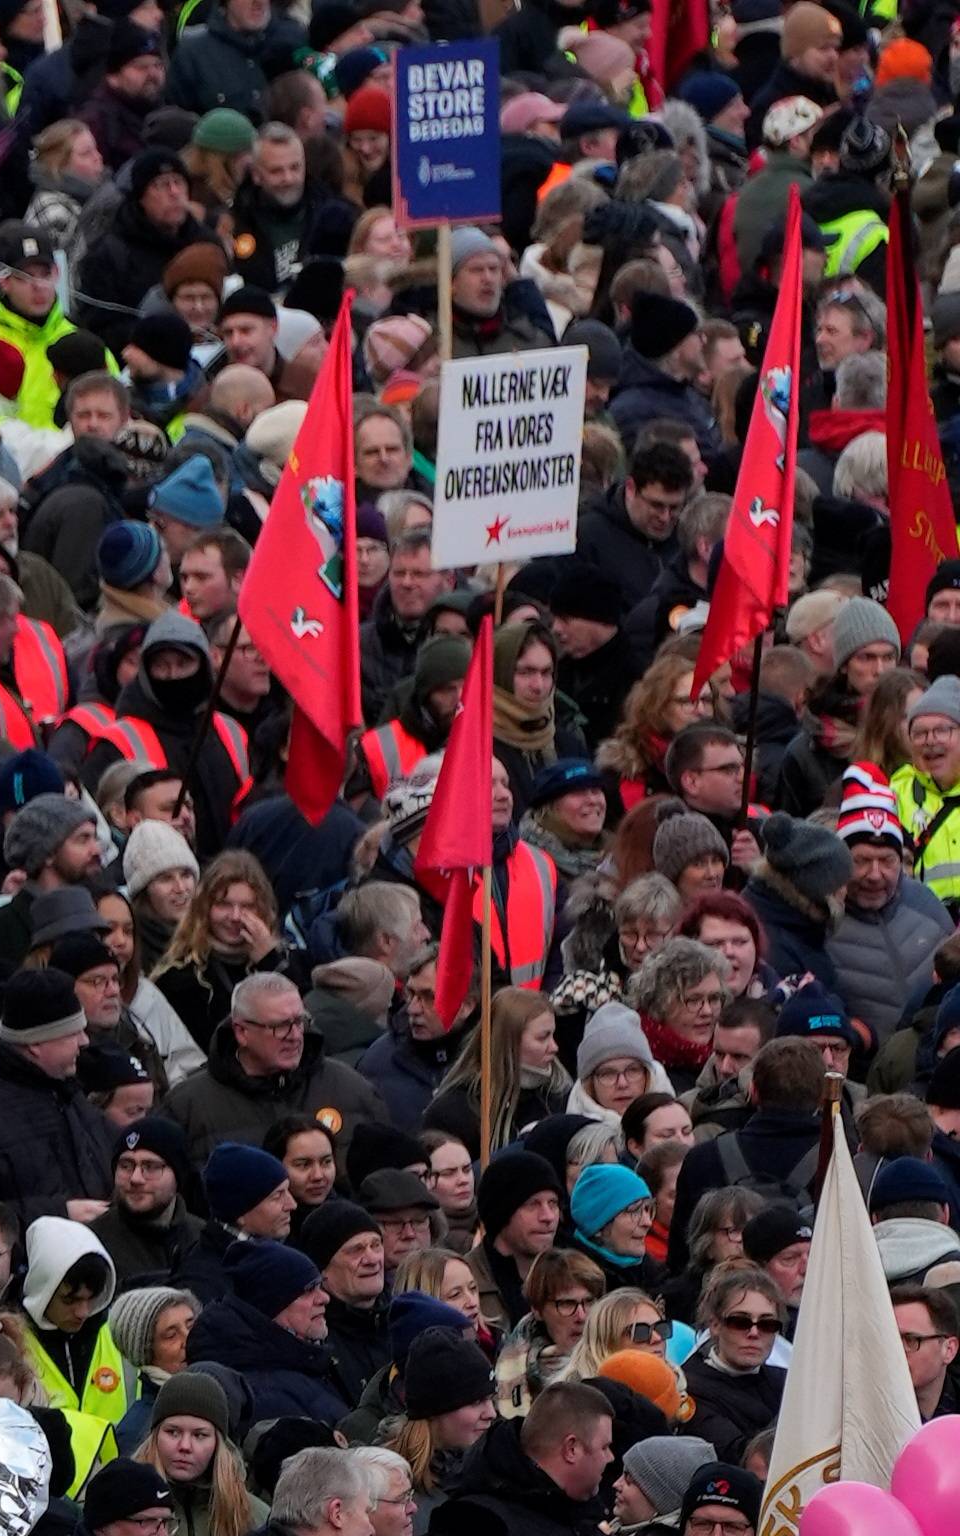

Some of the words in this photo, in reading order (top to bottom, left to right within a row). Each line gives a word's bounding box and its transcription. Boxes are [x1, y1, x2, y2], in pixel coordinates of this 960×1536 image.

[407, 59, 485, 93] BEVAR
[407, 87, 486, 120] STORE
[408, 115, 485, 142] BEDEDAG
[461, 366, 537, 410] NALLERNE
[540, 365, 572, 400] VÆK
[475, 419, 504, 452] FRA
[507, 411, 555, 449] VORES
[444, 453, 575, 501] OVERENSKOMSTER
